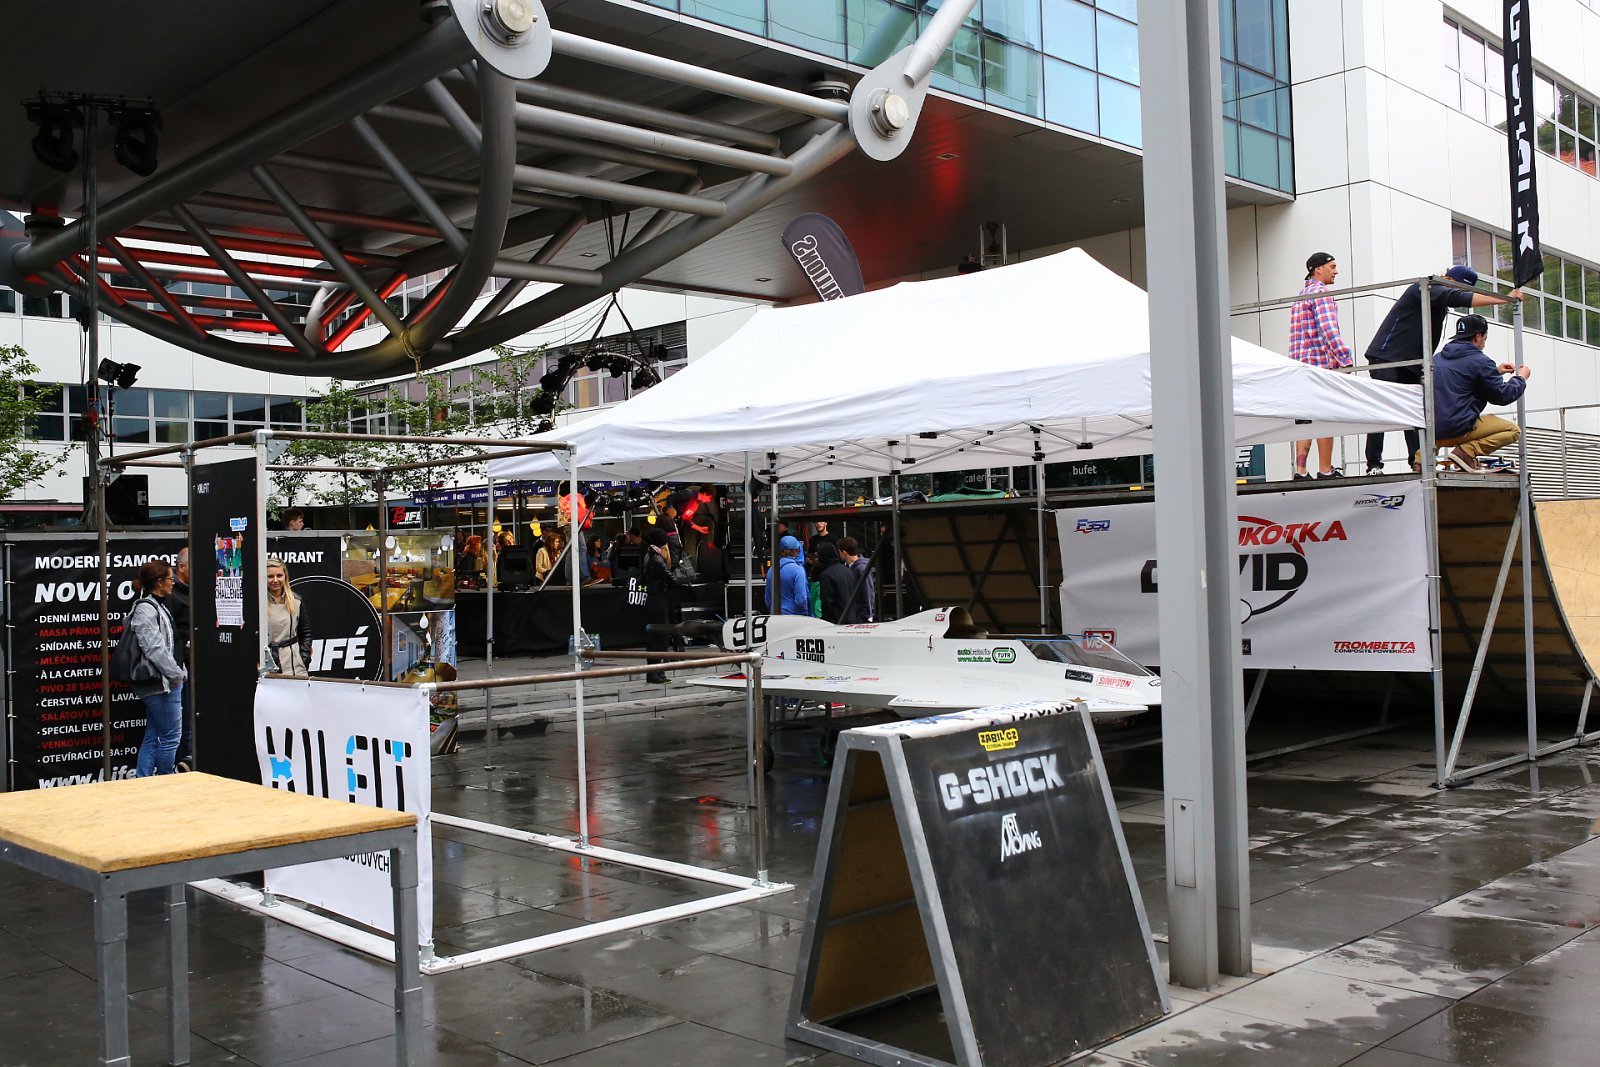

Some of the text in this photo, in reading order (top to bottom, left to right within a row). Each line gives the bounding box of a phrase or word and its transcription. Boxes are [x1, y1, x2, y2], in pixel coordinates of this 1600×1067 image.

[1072, 465, 1097, 476] bufet
[34, 552, 111, 570] MODERNÍ
[628, 591, 648, 606] OUR
[39, 612, 70, 624] DENNÍ
[71, 613, 99, 623] MENU
[39, 629, 68, 638] MASA
[733, 616, 769, 647] 98
[40, 638, 85, 652] SNÍDANĚ,
[308, 626, 369, 672] IFÉ
[1333, 641, 1416, 650] TROMBETTA
[796, 652, 824, 663] STUDIO
[49, 669, 62, 679] LA
[63, 668, 94, 678] CARTE
[40, 684, 64, 693] PIVO
[65, 683, 78, 692] ZE
[1098, 676, 1132, 689] SIMPSON
[40, 696, 83, 708] ČERSTVÁ
[41, 724, 80, 736] SPECIAL
[112, 717, 148, 729] CATERIN
[42, 750, 92, 764] OTEVÍRACÍ
[124, 746, 138, 755] PO
[938, 753, 1065, 811] G-SHOCK
